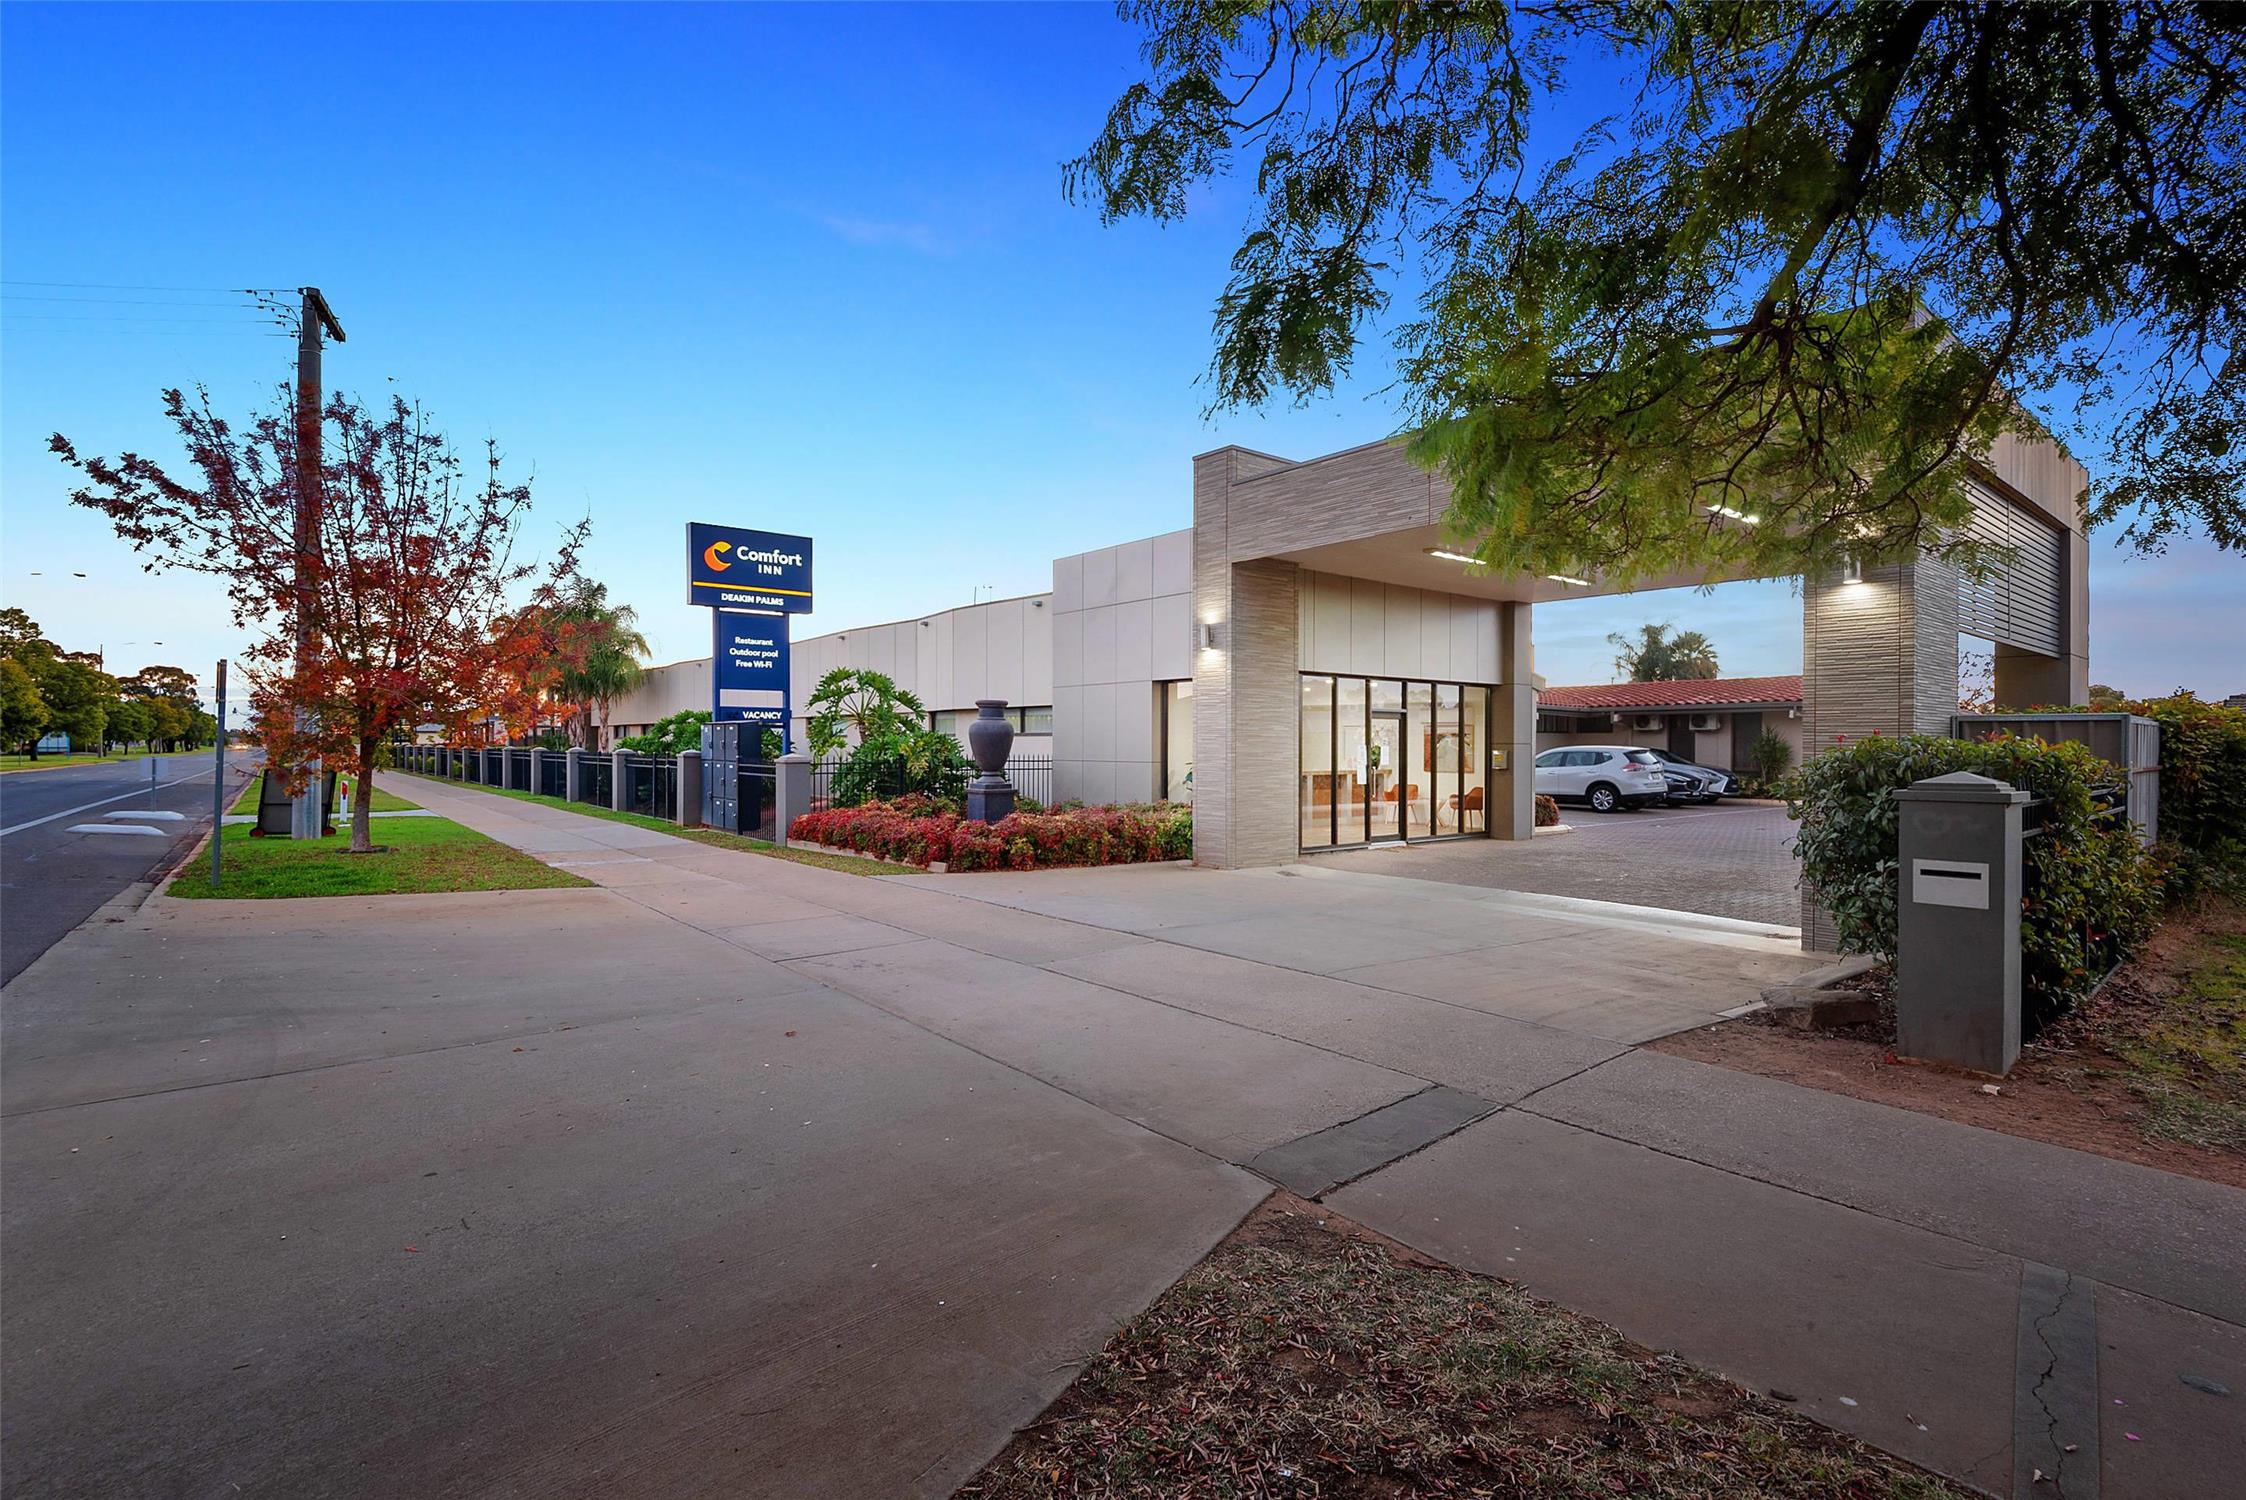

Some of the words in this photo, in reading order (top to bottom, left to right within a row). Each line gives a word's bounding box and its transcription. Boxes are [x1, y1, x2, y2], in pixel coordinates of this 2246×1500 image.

[736, 546, 802, 566] Comfort
[758, 564, 782, 575] INN
[721, 593, 755, 603] DEAKIN
[755, 595, 784, 605] PALMS
[735, 636, 773, 646] Restaurant
[729, 648, 761, 657] Outdoor
[761, 650, 779, 659] pool
[735, 660, 753, 668] Free
[753, 660, 773, 668] Wi-Fi
[742, 711, 782, 719] VACANCY
